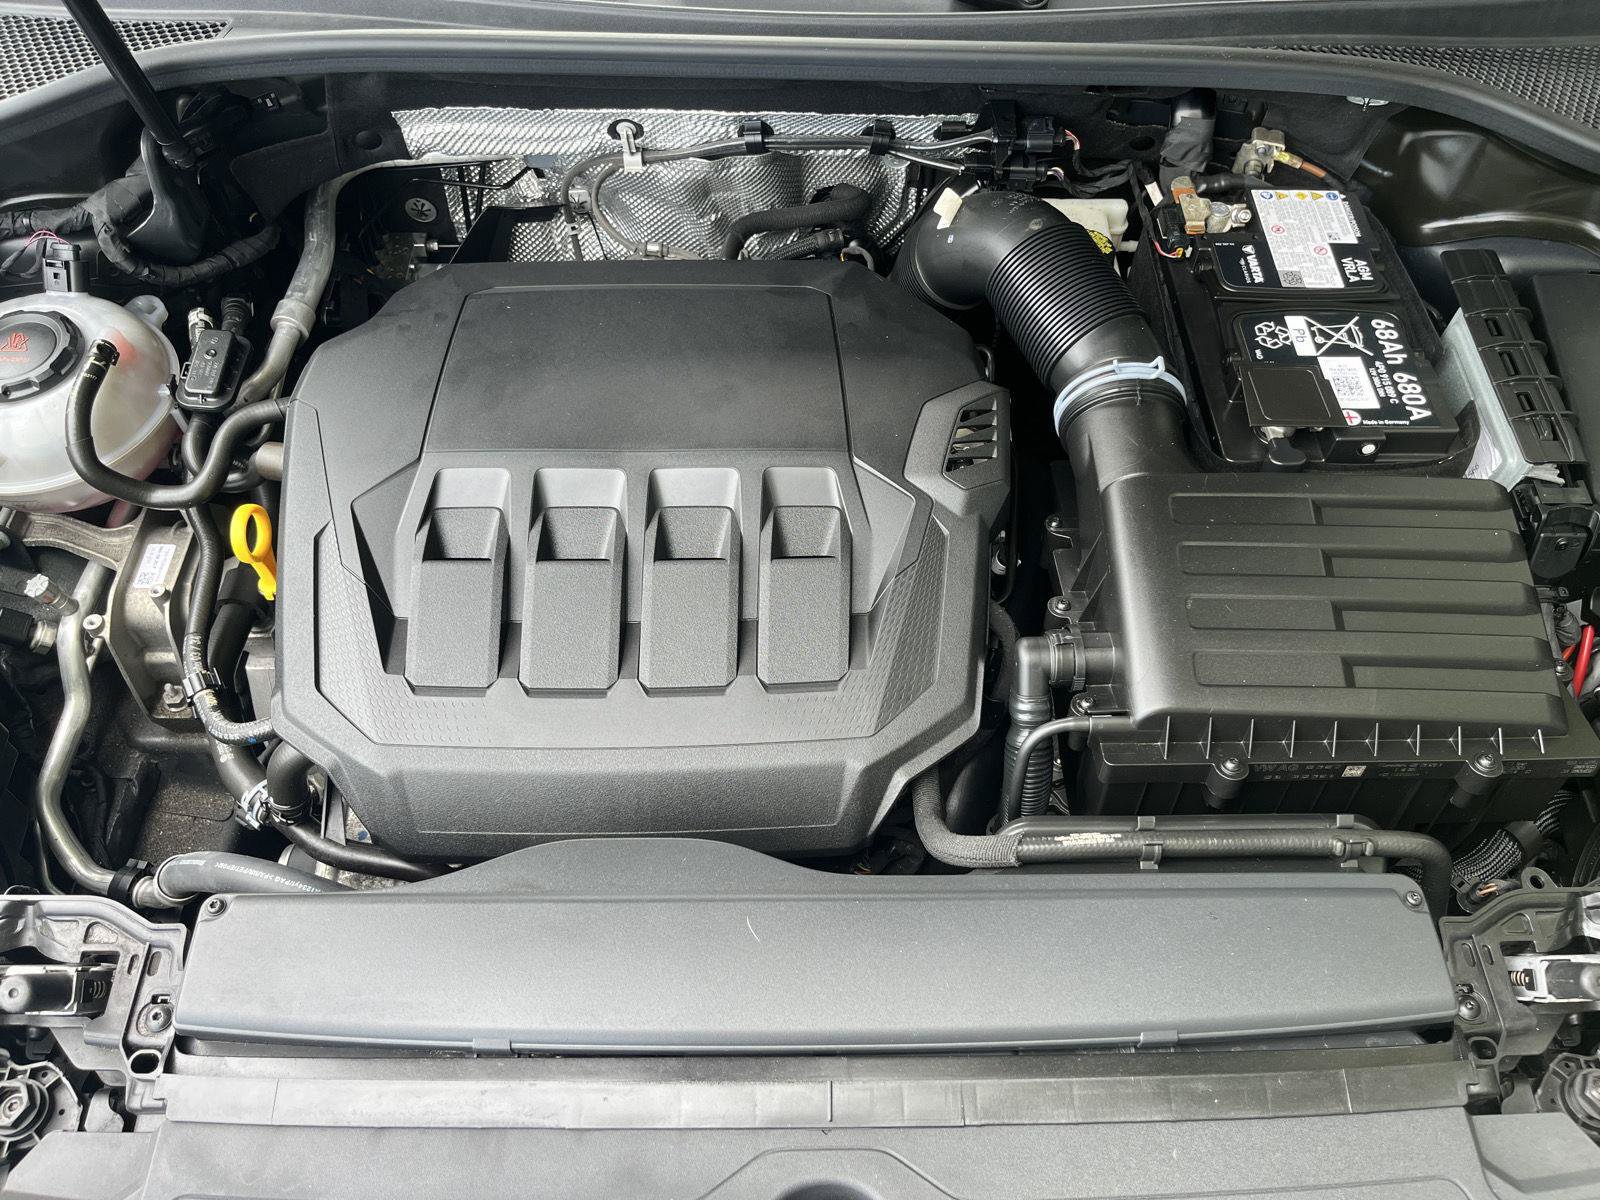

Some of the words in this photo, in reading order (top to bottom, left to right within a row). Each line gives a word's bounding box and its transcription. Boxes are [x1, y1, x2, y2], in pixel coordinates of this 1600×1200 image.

[1246, 254, 1265, 284] VARTA
[1341, 257, 1361, 283] VRLA
[1354, 259, 1374, 281] AGM
[1292, 328, 1307, 343] Pb
[1370, 319, 1408, 365] 68Ah
[1392, 372, 1432, 421] 680A
[1379, 374, 1392, 386] 915
